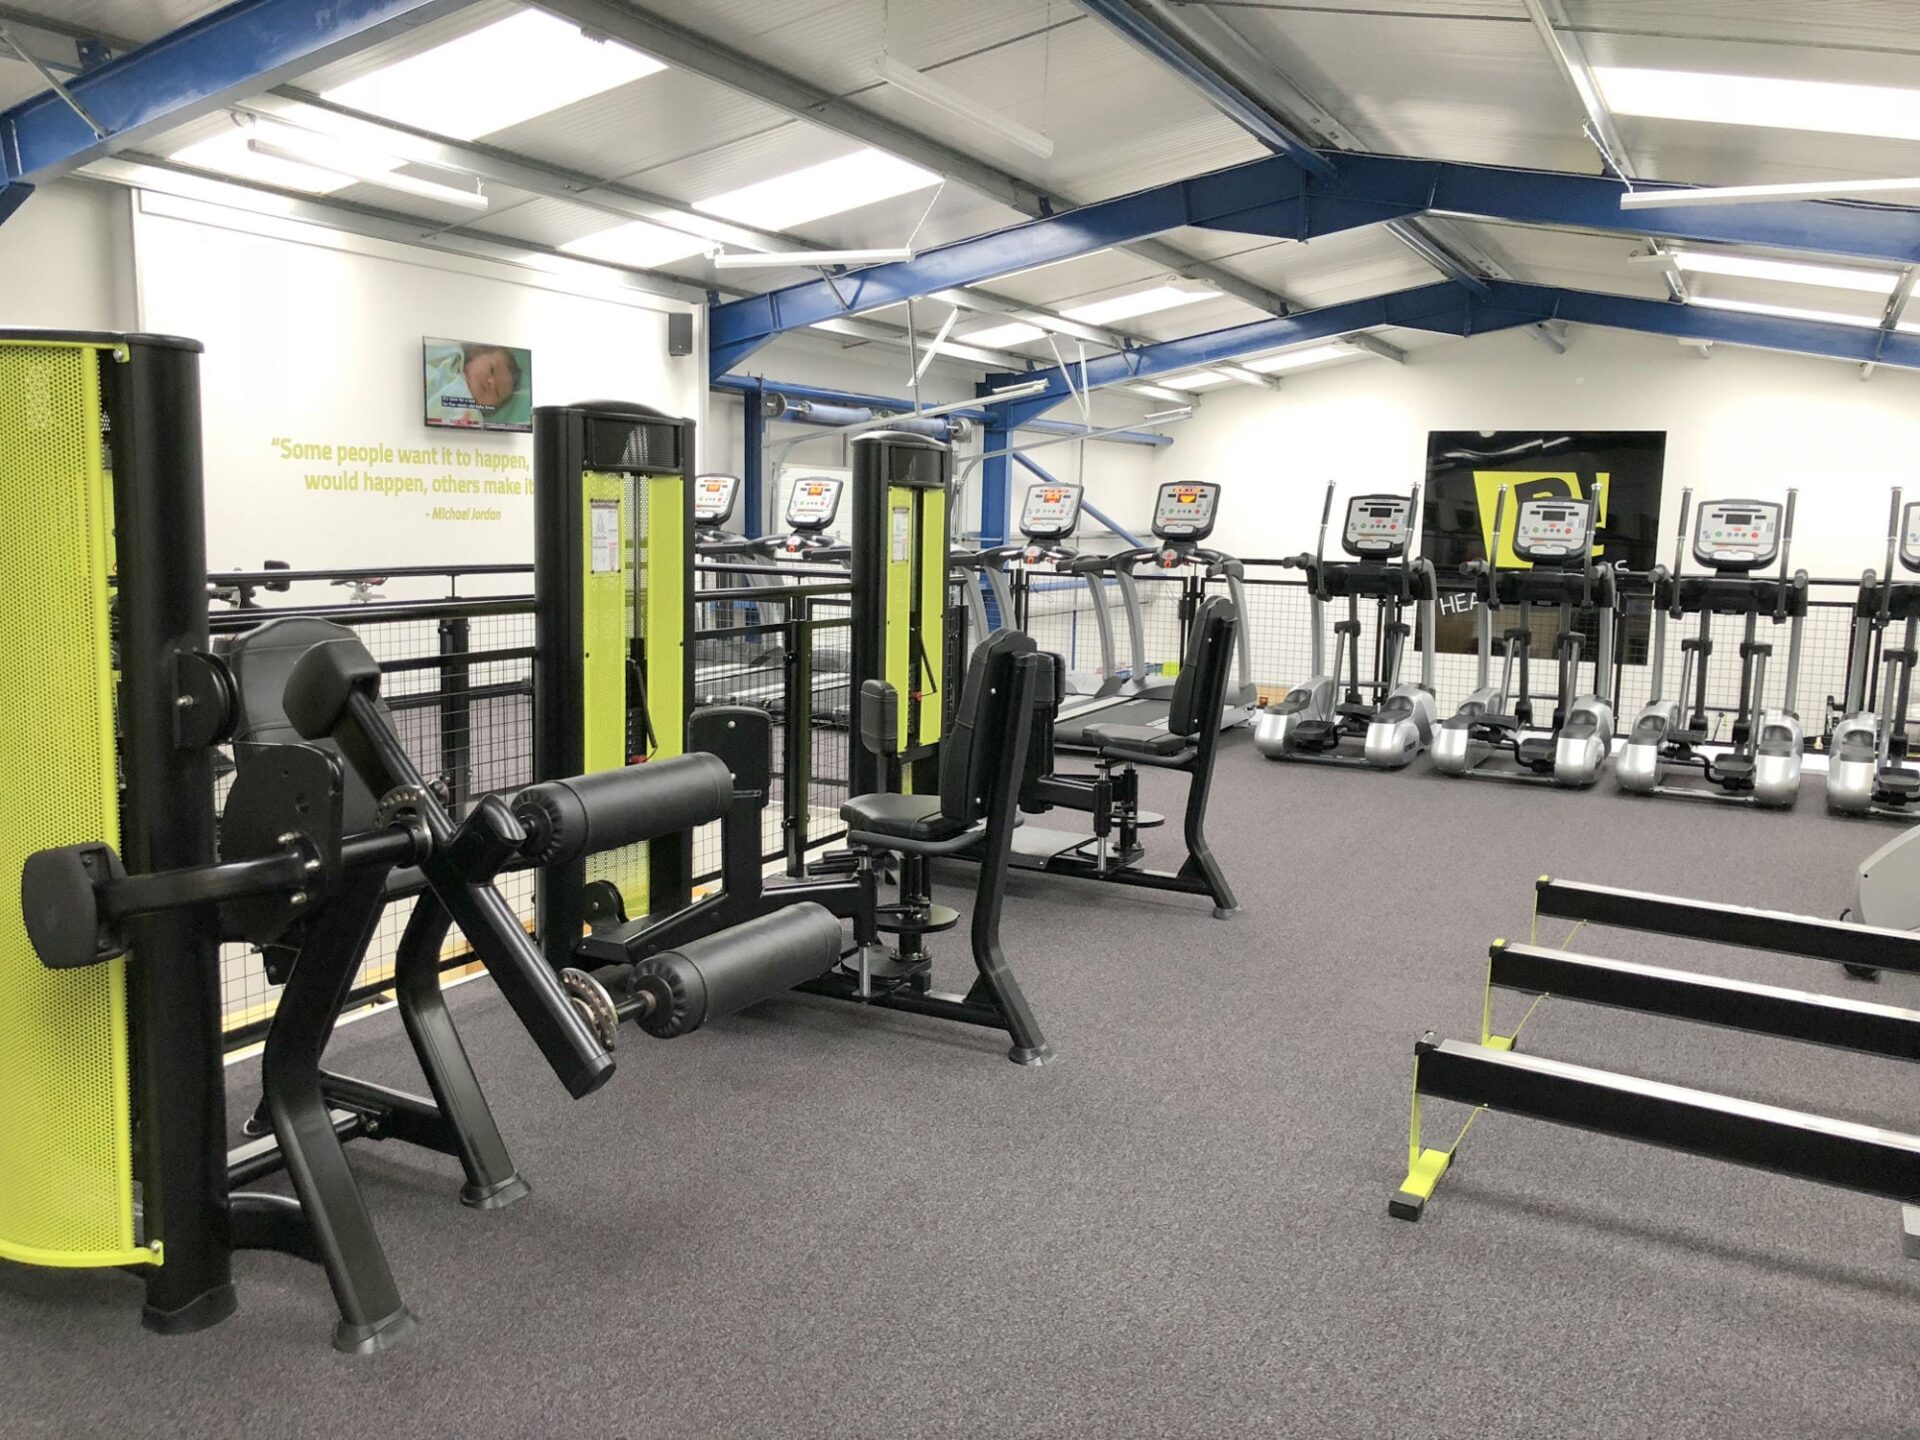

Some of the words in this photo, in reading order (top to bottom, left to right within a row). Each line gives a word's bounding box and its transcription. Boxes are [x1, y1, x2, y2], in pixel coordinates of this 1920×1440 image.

[337, 442, 394, 467] people
[397, 447, 438, 464] want
[441, 447, 453, 465] it
[456, 449, 471, 466] to
[475, 448, 529, 472] happen,
[304, 470, 359, 490] would
[364, 471, 428, 496] happen,
[432, 474, 480, 493] others
[483, 476, 521, 494] make
[432, 507, 470, 520] Michael
[471, 508, 502, 521] Jordan
